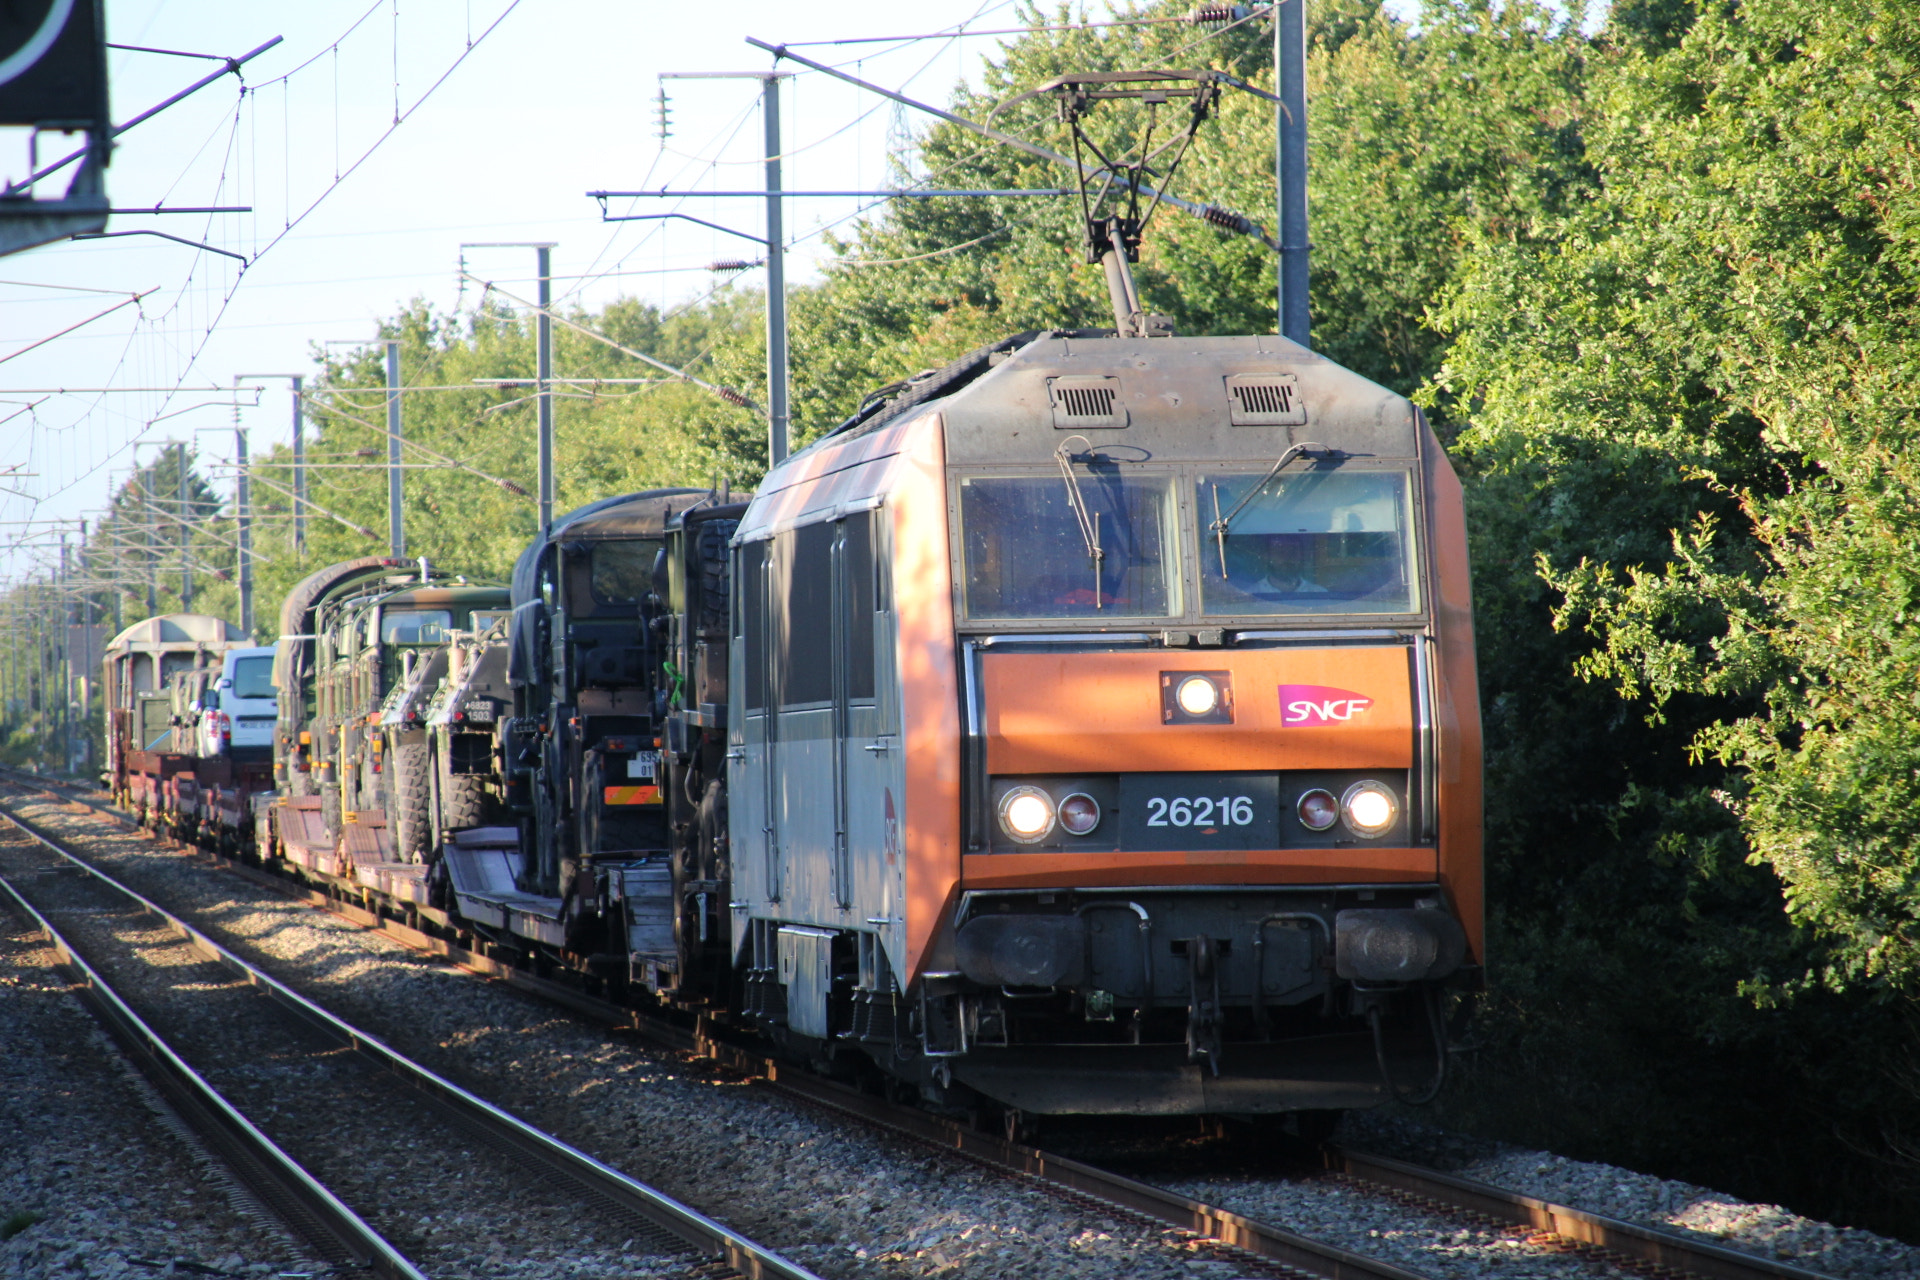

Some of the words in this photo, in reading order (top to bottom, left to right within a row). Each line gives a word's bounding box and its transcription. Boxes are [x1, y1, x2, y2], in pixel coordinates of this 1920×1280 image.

[467, 711, 489, 721] 1503
[1285, 699, 1369, 722] SNCF
[1147, 796, 1254, 827] 26216
